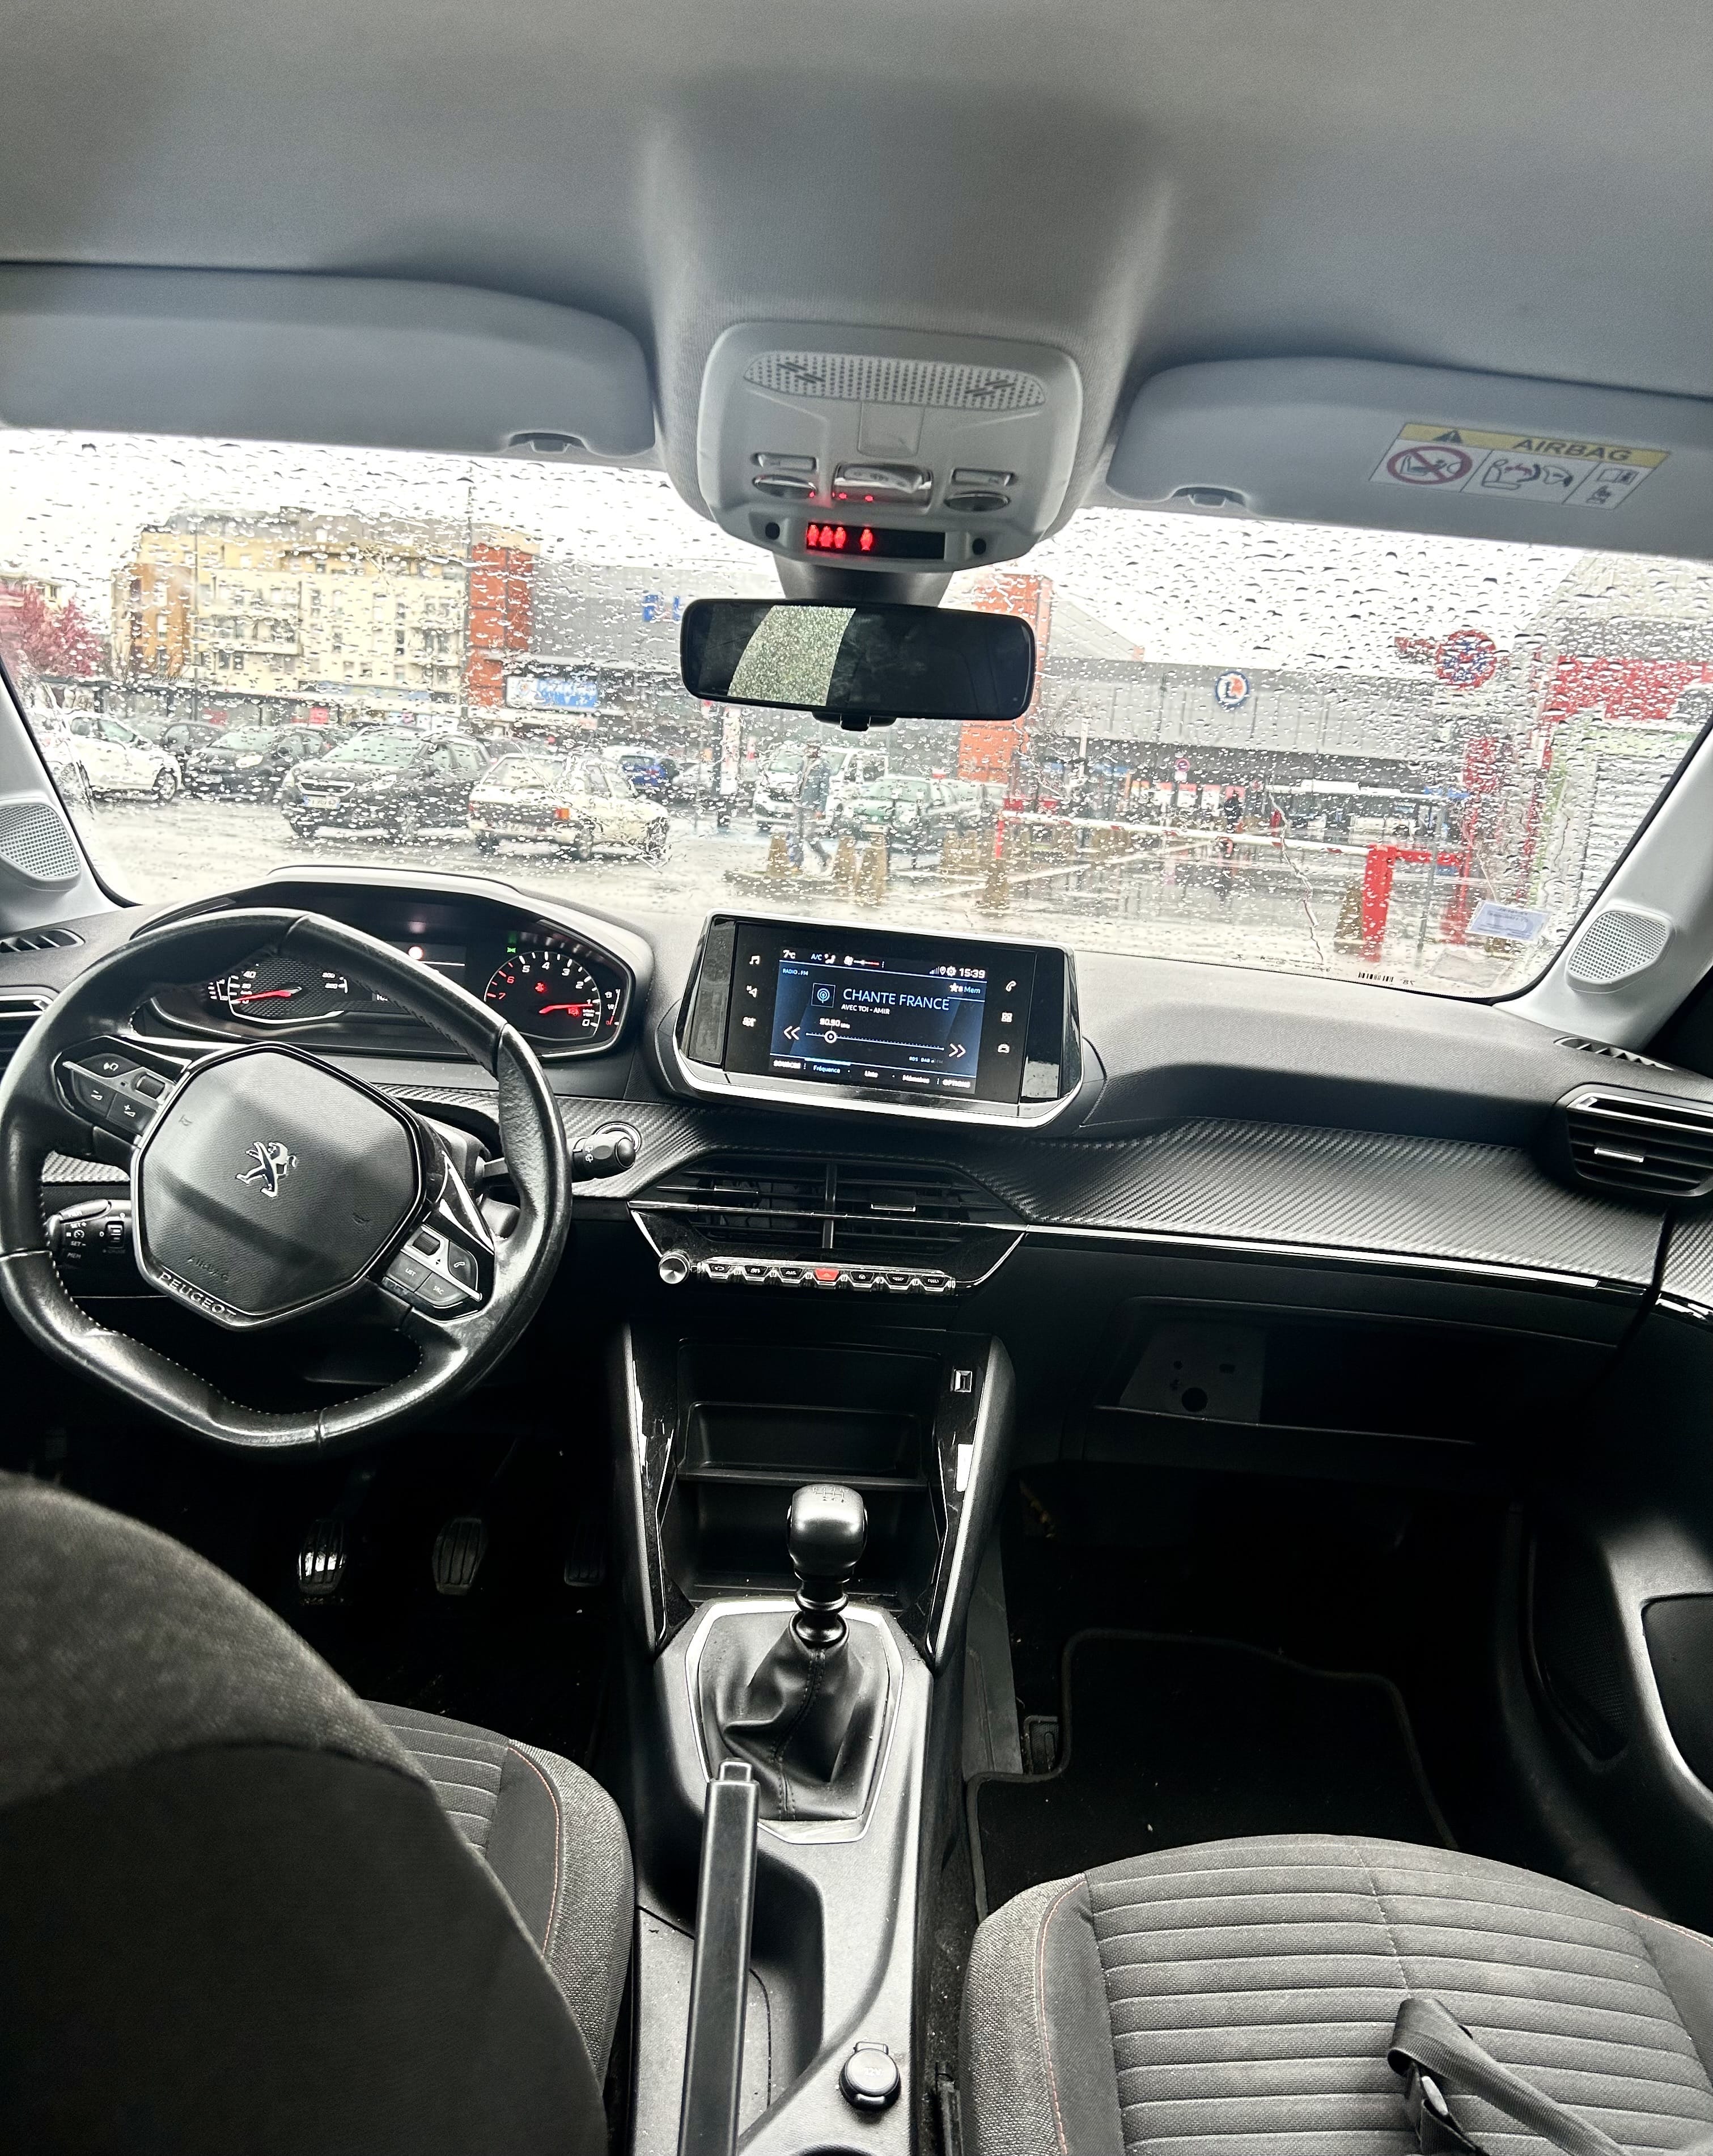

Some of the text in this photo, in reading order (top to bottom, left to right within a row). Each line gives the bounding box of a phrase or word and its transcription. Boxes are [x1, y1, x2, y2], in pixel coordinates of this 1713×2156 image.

[1512, 439, 1633, 461] AIRBAG
[959, 968, 986, 979] 15:39
[843, 988, 949, 1011] CHANTE FRANCE
[841, 1003, 857, 1012] AVEC
[813, 1064, 841, 1074] Fréquence
[405, 1268, 416, 1277] LIST
[159, 1272, 237, 1318] PEUGEOT
[433, 1285, 444, 1295] SRC
